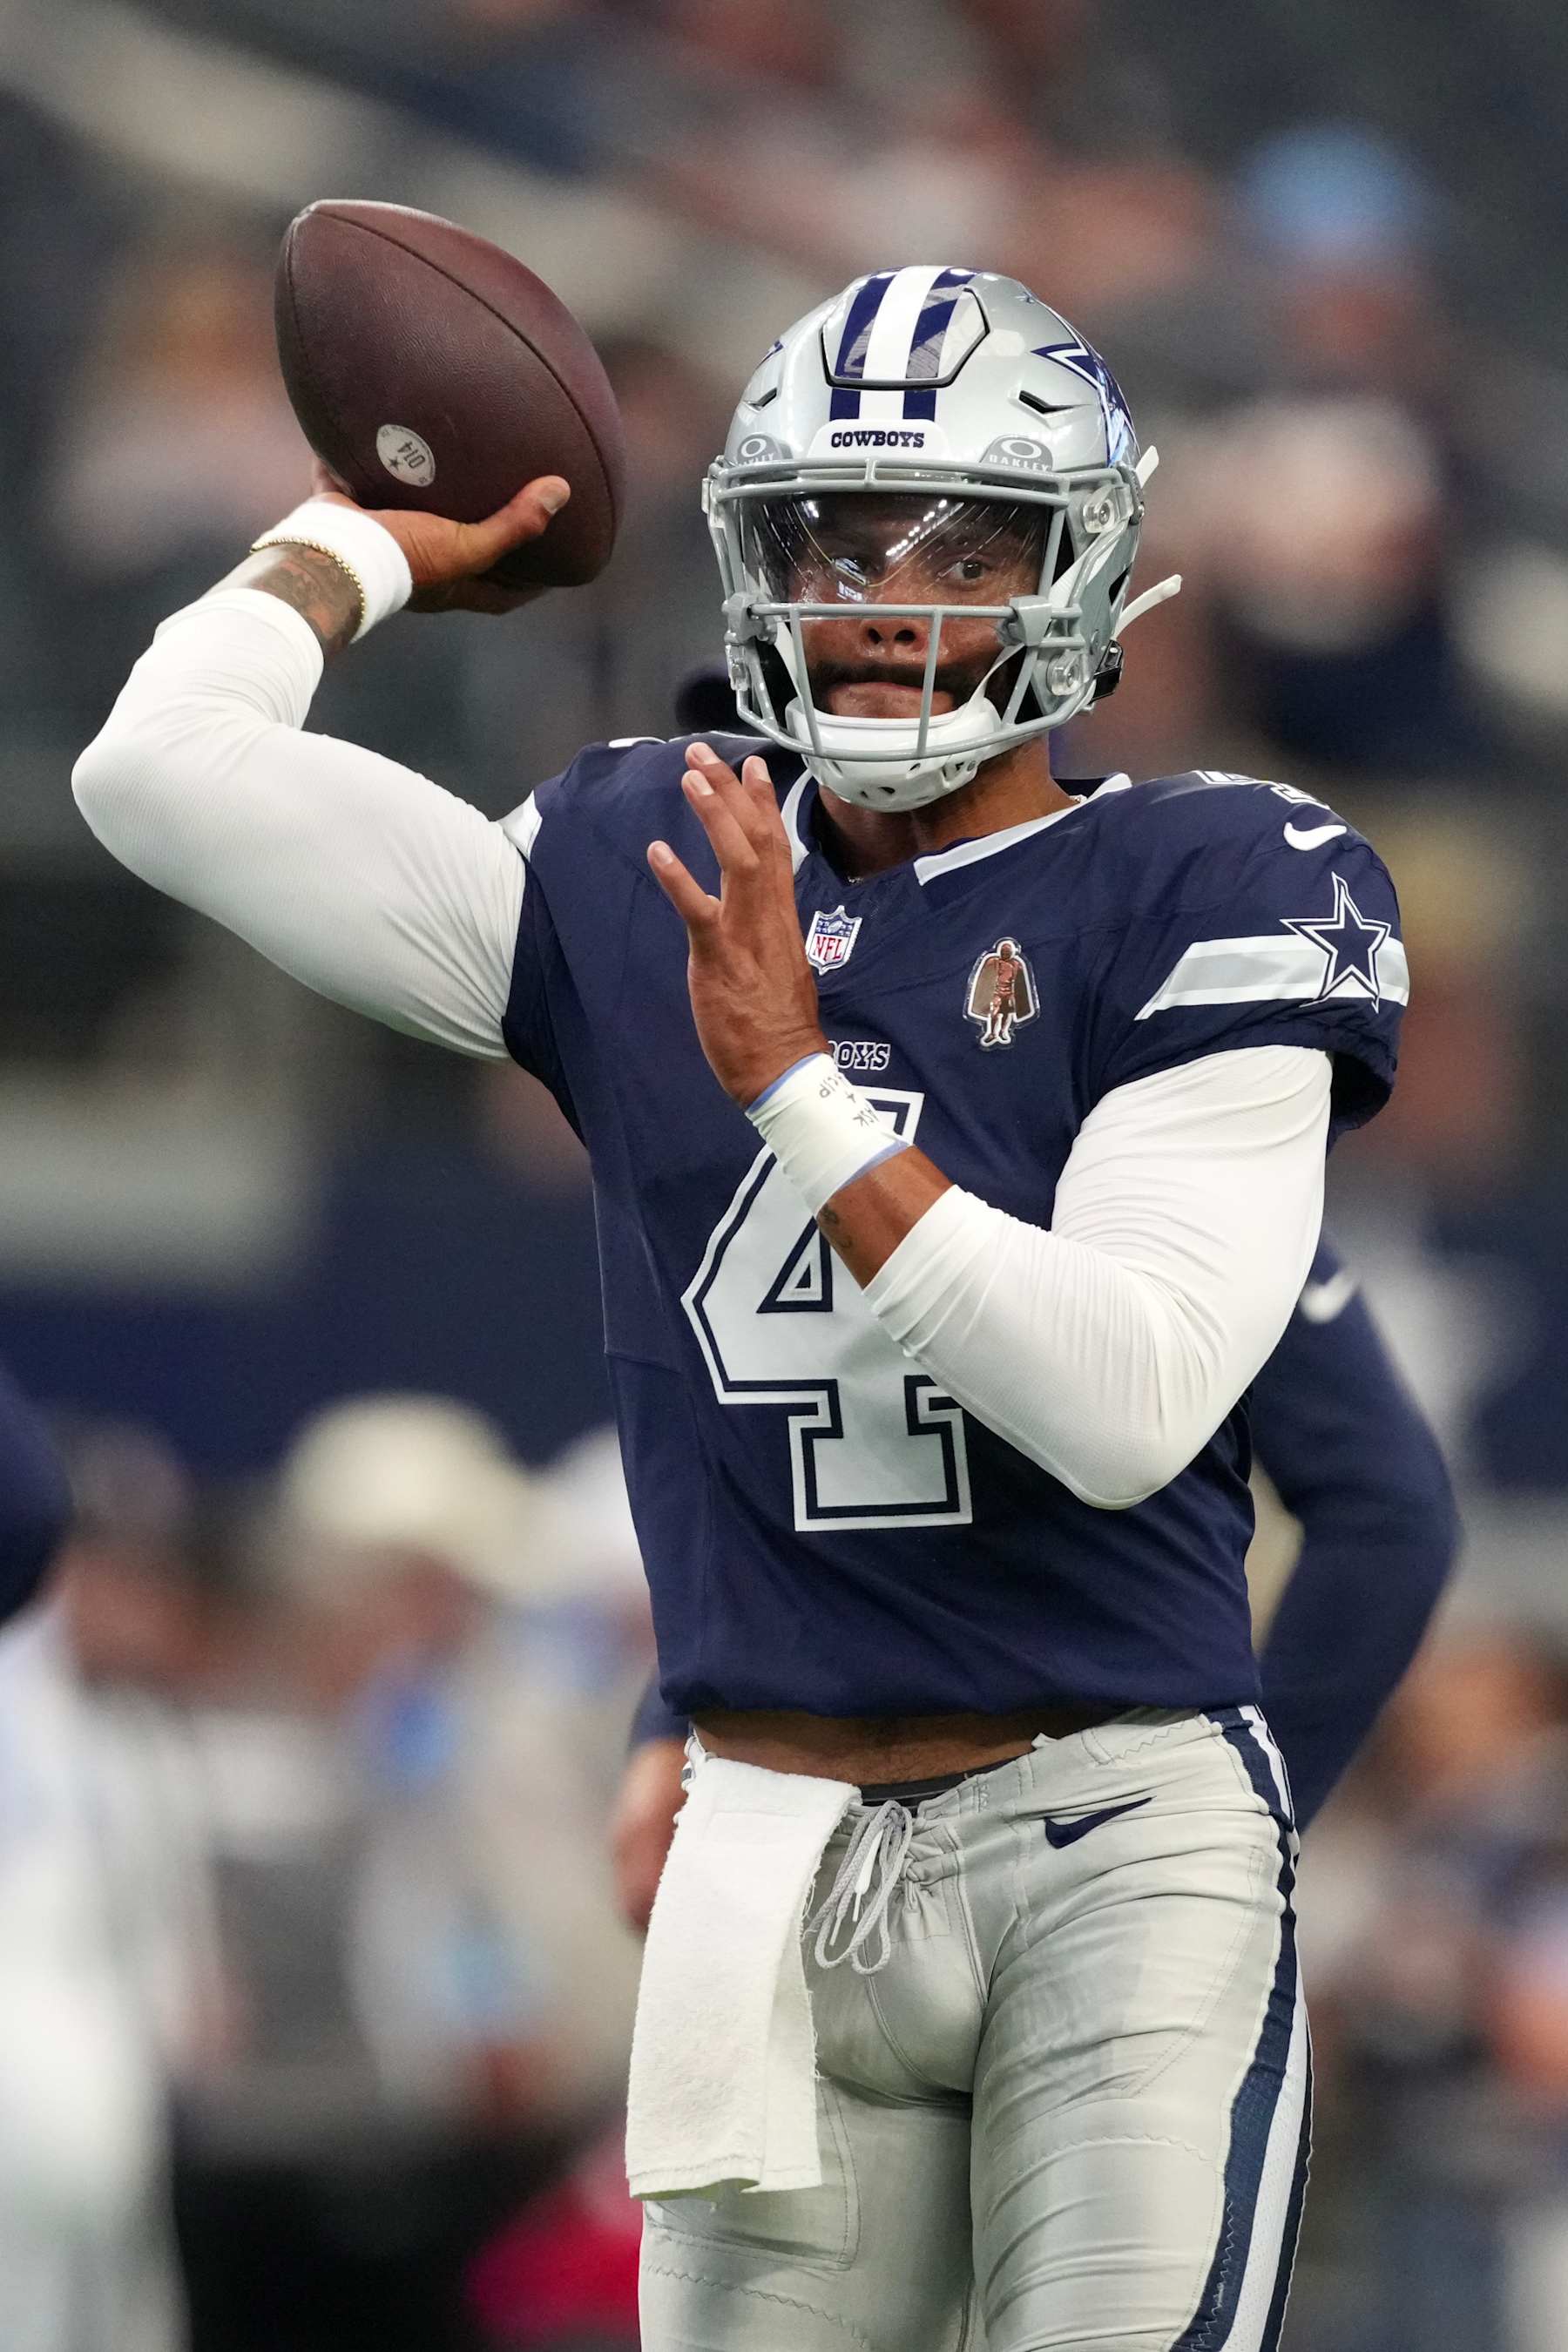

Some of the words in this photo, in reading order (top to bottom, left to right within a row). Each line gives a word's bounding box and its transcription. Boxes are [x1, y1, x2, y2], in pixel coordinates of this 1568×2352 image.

[831, 430, 925, 448] COWBOYS
[814, 935, 842, 961] NFL
[680, 1085, 973, 1531] 4
